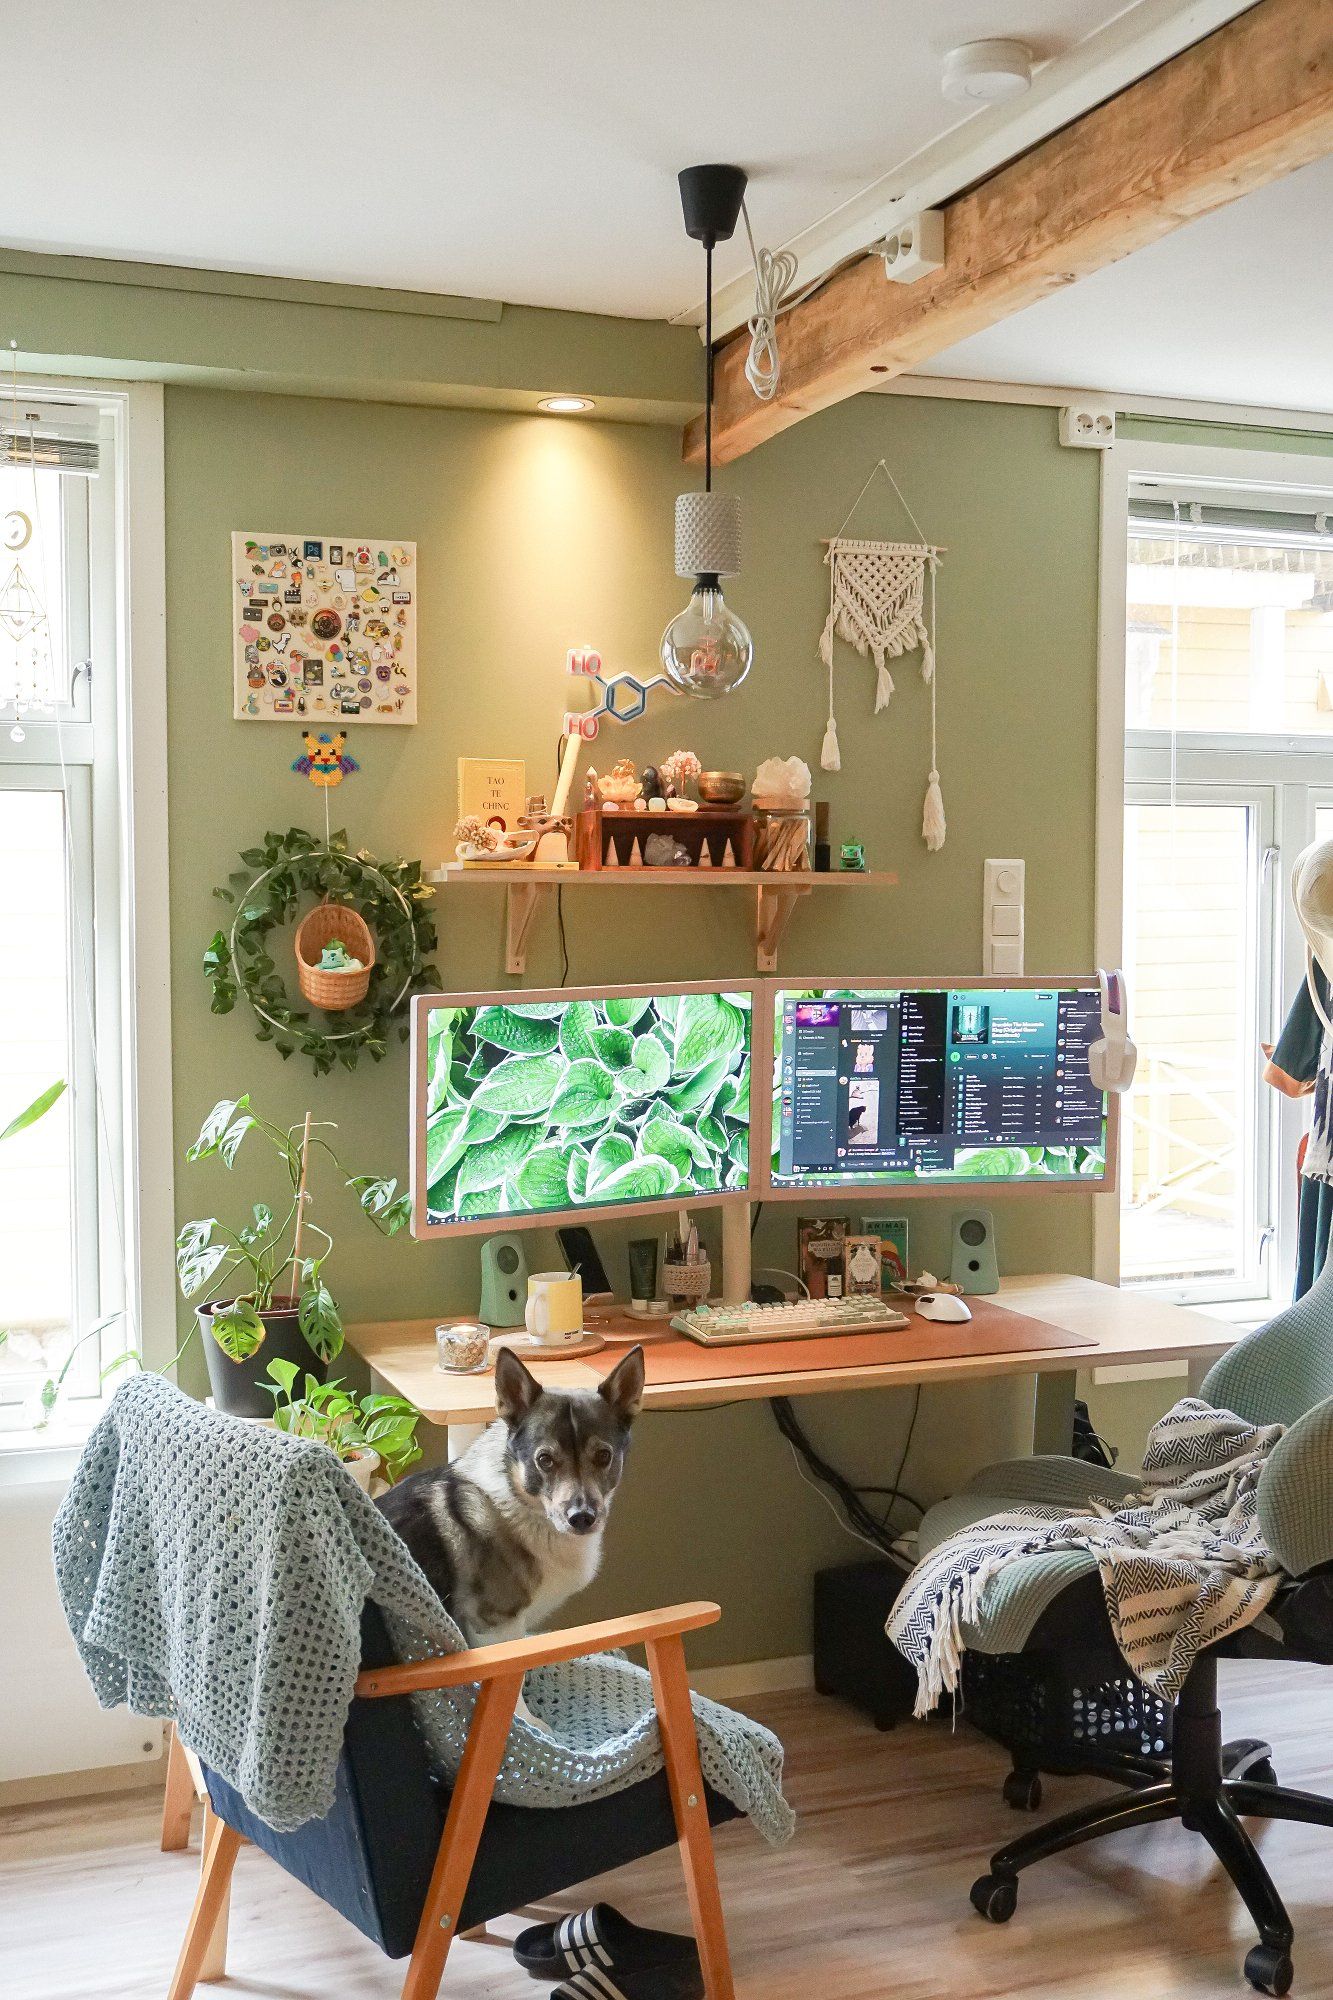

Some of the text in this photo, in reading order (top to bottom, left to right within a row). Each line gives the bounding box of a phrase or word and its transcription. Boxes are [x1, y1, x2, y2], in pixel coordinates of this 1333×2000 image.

[307, 544, 320, 556] Ps
[571, 653, 602, 675] HO
[568, 716, 599, 739] HO
[487, 776, 505, 785] TAO
[490, 789, 502, 798] TE
[482, 801, 510, 811] CHING
